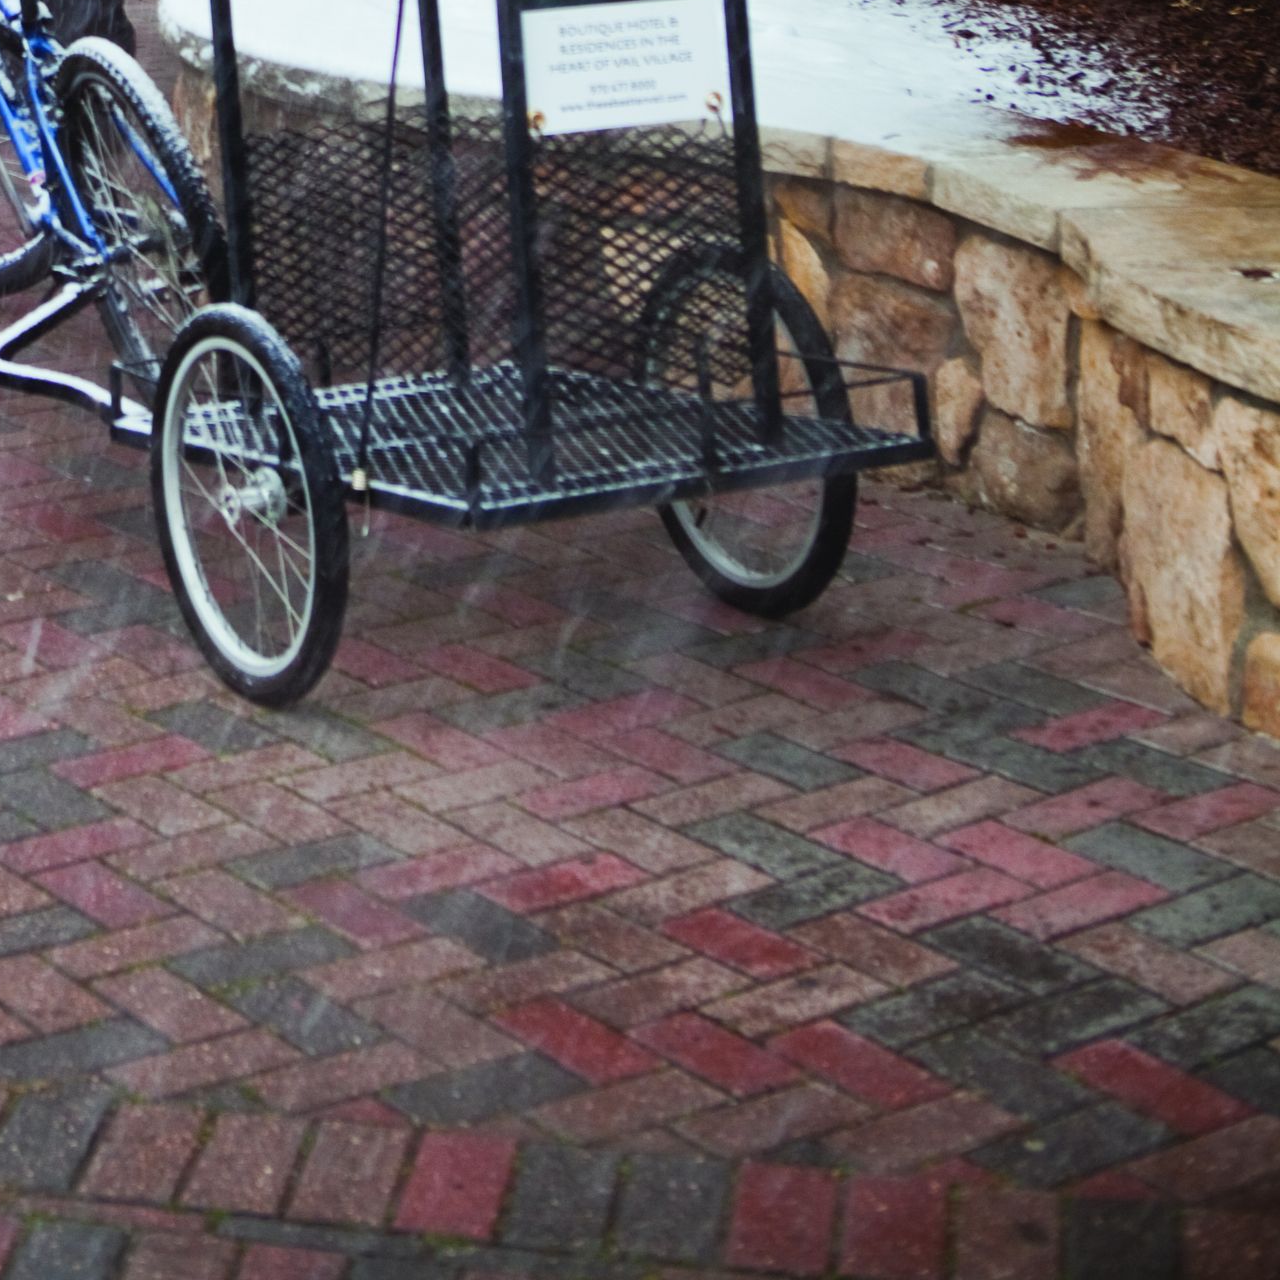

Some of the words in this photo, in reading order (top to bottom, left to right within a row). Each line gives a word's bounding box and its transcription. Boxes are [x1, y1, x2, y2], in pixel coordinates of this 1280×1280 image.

[558, 22, 624, 37] BOUTIQUE
[626, 18, 666, 32] HOTEL
[559, 39, 637, 55] RESIDENCES
[640, 37, 655, 47] IN
[657, 34, 680, 46] THE
[549, 60, 591, 74] HEART
[593, 58, 610, 71] OF
[613, 56, 640, 68] VAIL
[642, 50, 693, 65] VILLAGE
